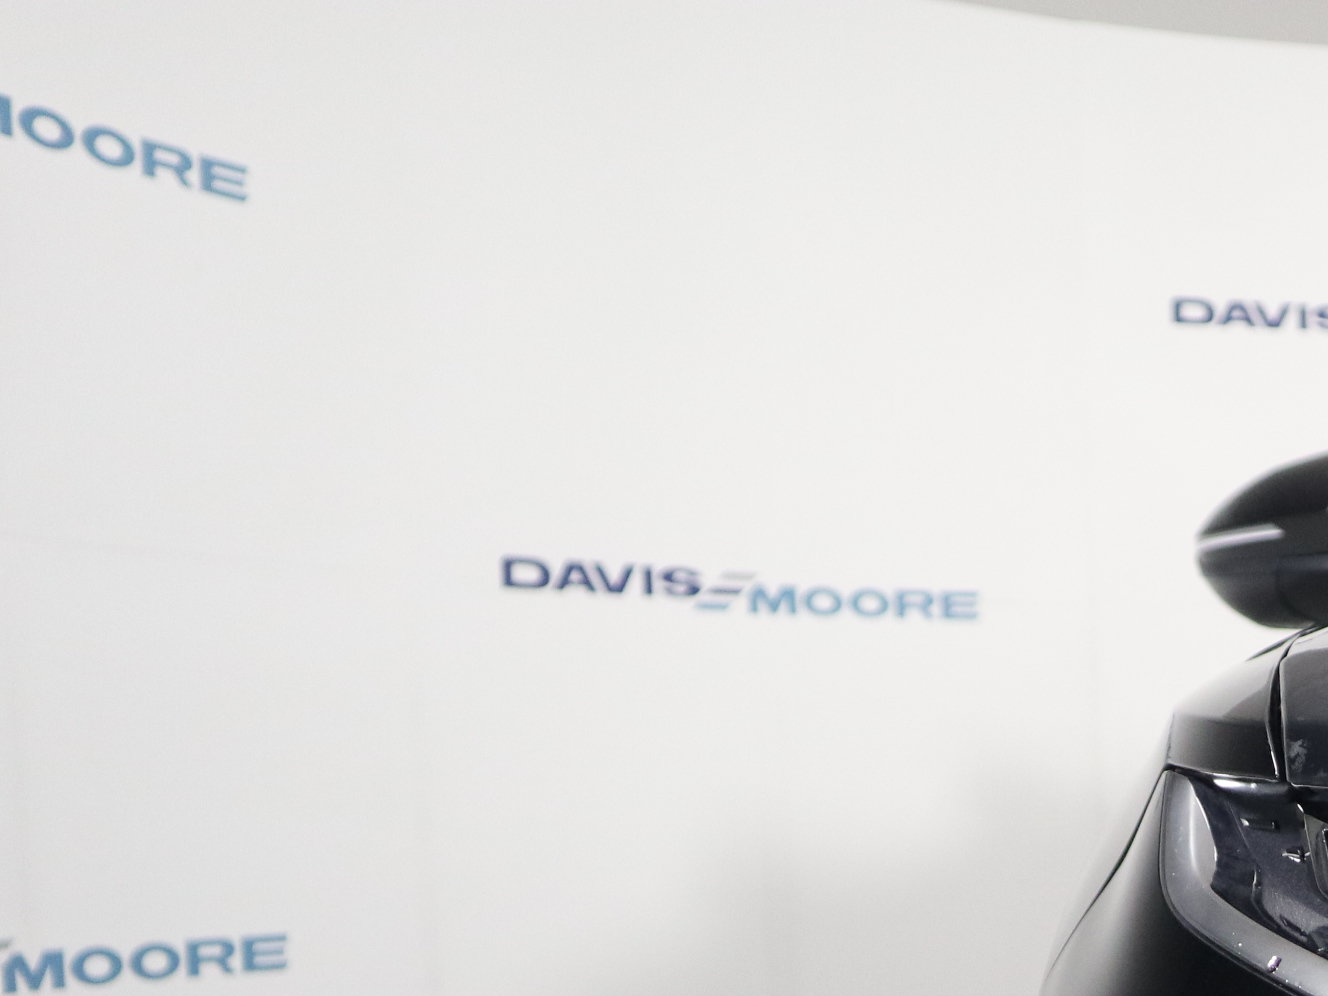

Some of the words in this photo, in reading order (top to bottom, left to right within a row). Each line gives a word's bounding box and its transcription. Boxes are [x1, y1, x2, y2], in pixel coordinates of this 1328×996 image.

[0, 93, 247, 202] OORE
[500, 554, 703, 599] DAVIS
[748, 583, 979, 621] MOORE
[2, 931, 289, 994] MOORE
